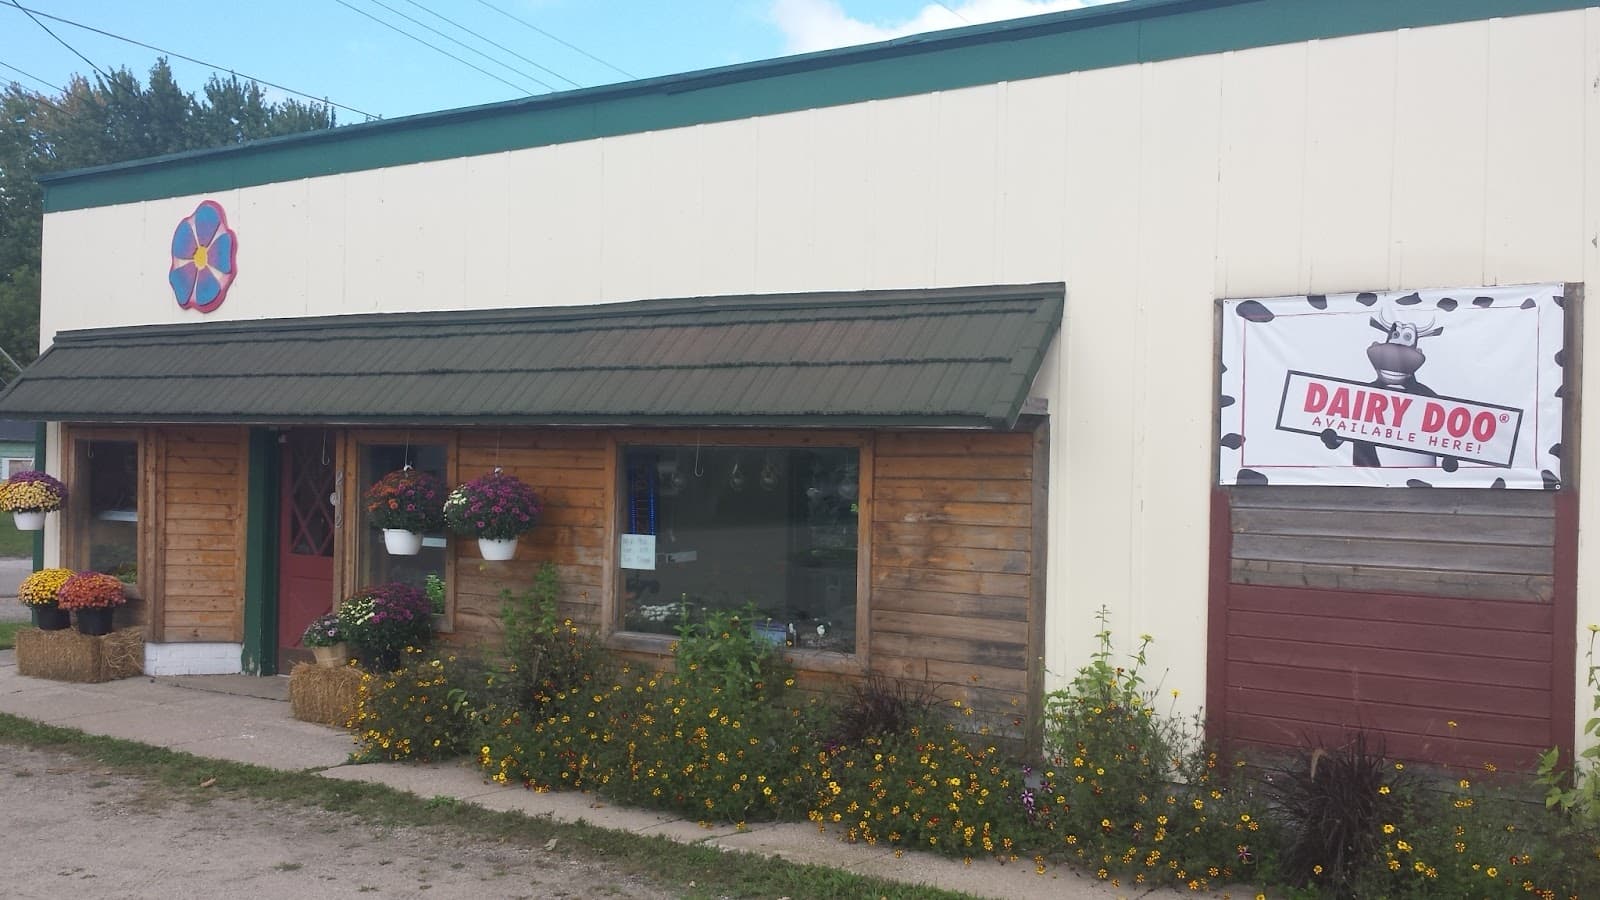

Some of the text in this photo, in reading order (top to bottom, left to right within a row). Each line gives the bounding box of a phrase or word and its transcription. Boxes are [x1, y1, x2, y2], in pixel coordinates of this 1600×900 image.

[1303, 382, 1413, 428] DAIRY
[1312, 416, 1482, 454] AVAILABLE HERE!
